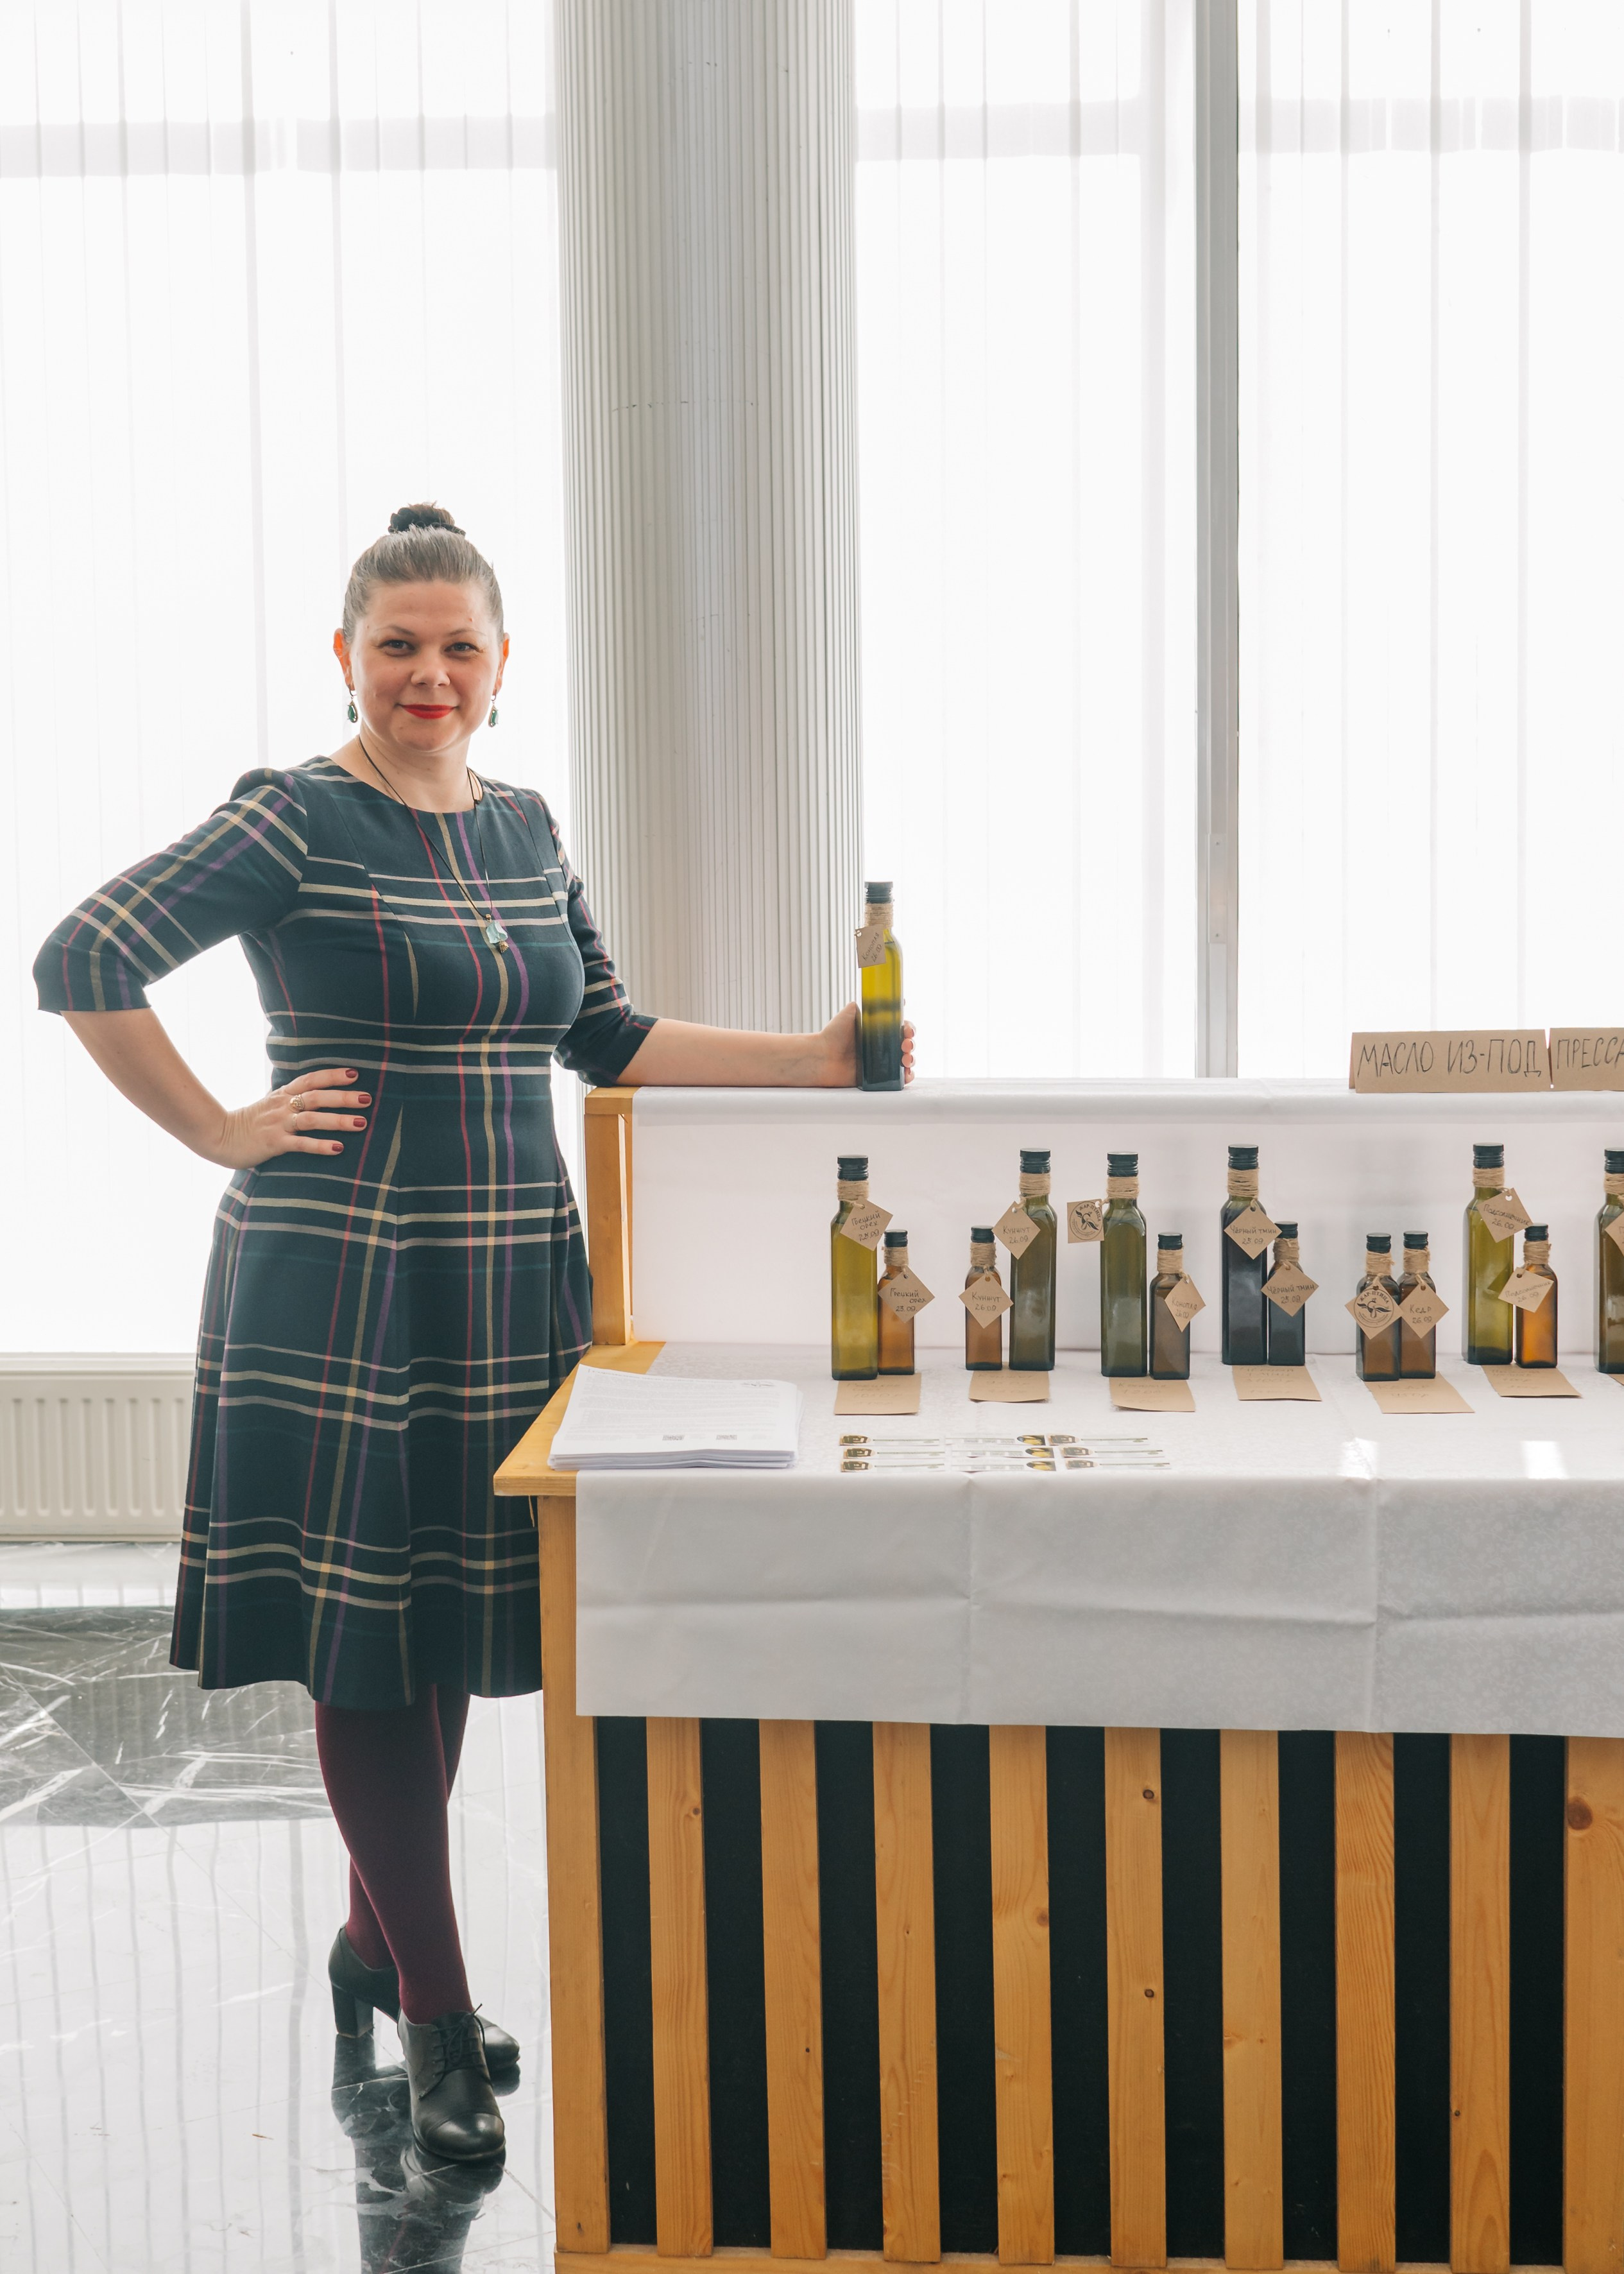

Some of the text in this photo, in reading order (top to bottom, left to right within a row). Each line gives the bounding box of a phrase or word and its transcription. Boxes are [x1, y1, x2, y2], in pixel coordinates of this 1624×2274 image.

[1357, 1038, 1542, 1078] МАСЛО ИЗ-ПОД
[851, 1210, 880, 1227] Грецкий
[860, 1221, 878, 1230] орех
[1003, 1225, 1030, 1234] Кунжут
[1230, 1225, 1256, 1234] Чёрный
[891, 1288, 919, 1298] Грецкий
[1267, 1284, 1295, 1295] Чёрный
[972, 1291, 1002, 1302] Кунжут
[1360, 1291, 1389, 1304] ЖАР-ПТИЦА
[1410, 1304, 1432, 1314] Кедр
